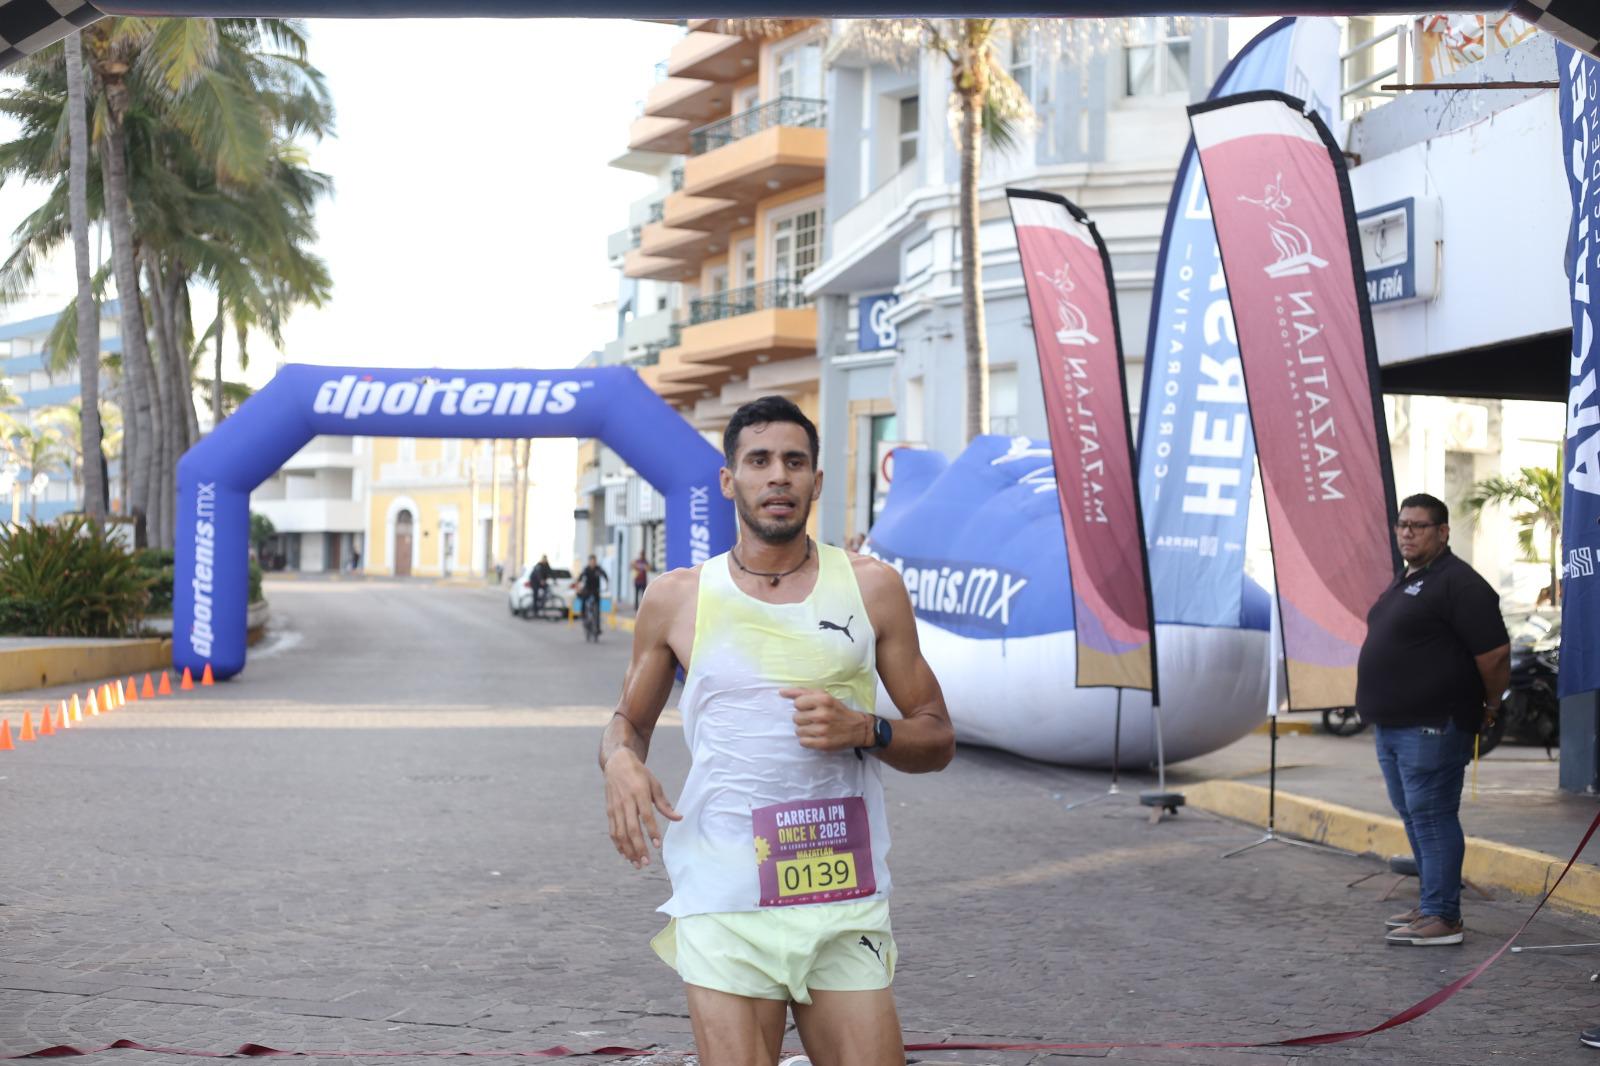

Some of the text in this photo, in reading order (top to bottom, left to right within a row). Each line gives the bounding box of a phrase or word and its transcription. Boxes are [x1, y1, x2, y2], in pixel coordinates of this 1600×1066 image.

[313, 375, 582, 419] dportenis
[190, 481, 216, 658] dportenis.mx
[776, 804, 845, 828] CARRERA IPN
[778, 821, 847, 844] ONCE K 2026
[784, 860, 849, 890] 0139
